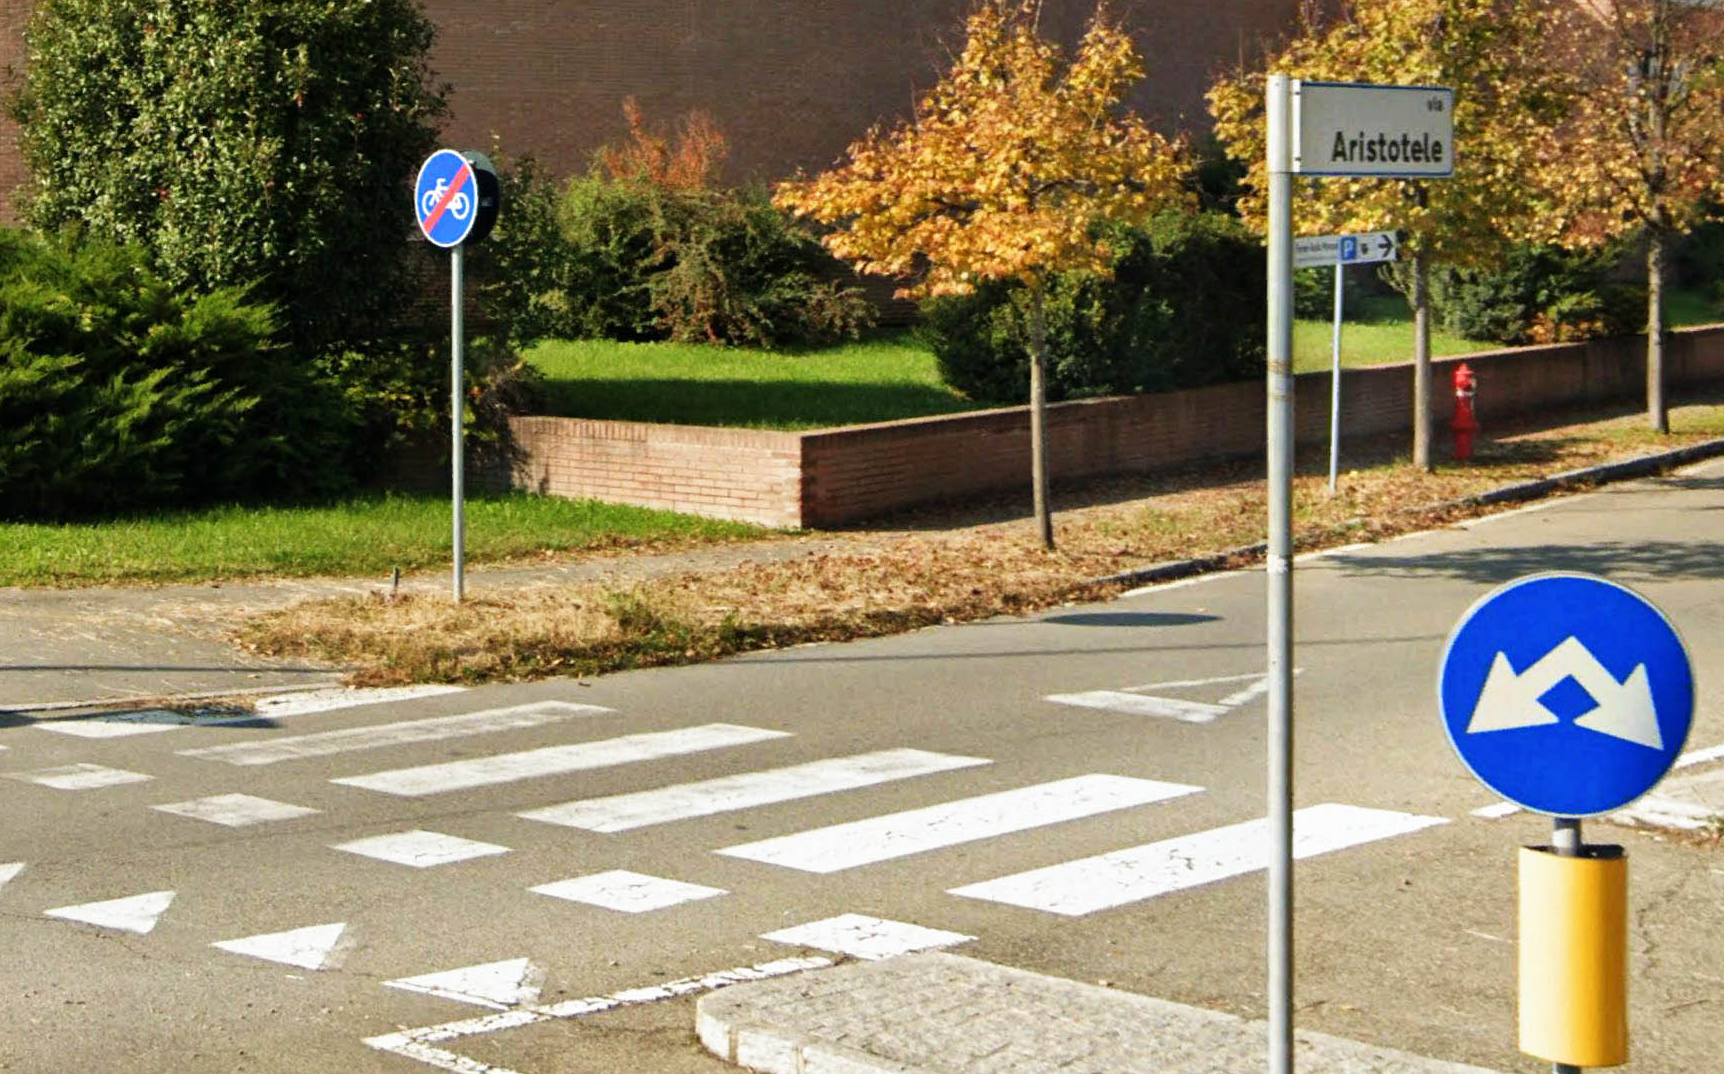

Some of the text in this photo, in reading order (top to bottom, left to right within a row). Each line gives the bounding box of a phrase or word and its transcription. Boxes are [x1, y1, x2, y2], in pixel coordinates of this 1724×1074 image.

[1427, 96, 1444, 112] via
[1331, 131, 1443, 163] Aristotele
[1343, 239, 1354, 258] P
